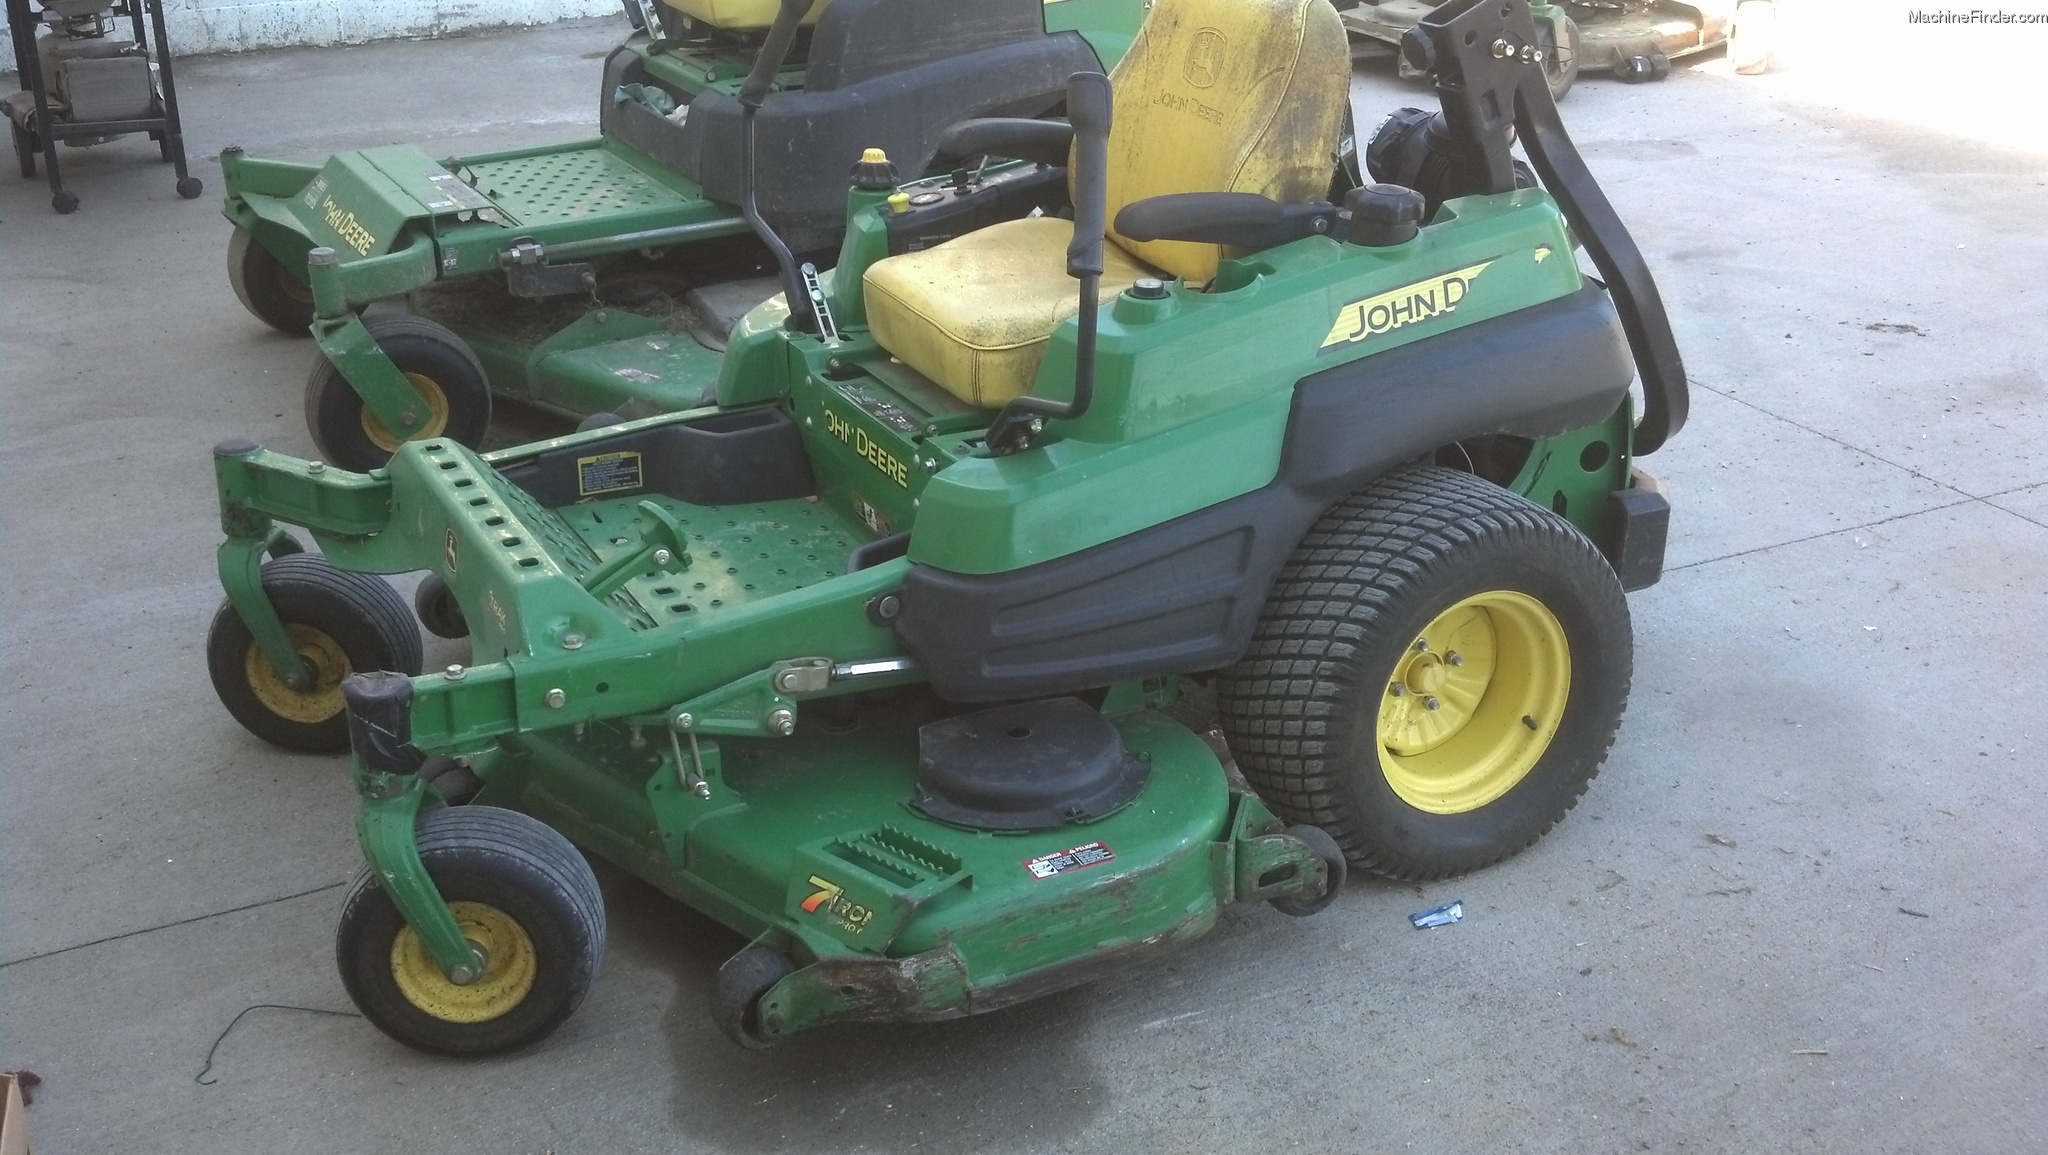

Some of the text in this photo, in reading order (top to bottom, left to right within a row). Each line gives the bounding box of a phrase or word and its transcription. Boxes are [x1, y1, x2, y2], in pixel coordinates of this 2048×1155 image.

[1153, 89, 1225, 127] JOHN DEERE
[337, 211, 376, 257] DEERE
[1350, 290, 1436, 340] JOHN
[857, 427, 908, 489] DEERE
[1037, 852, 1062, 862] DANGER
[1075, 842, 1099, 852] PELIGRO
